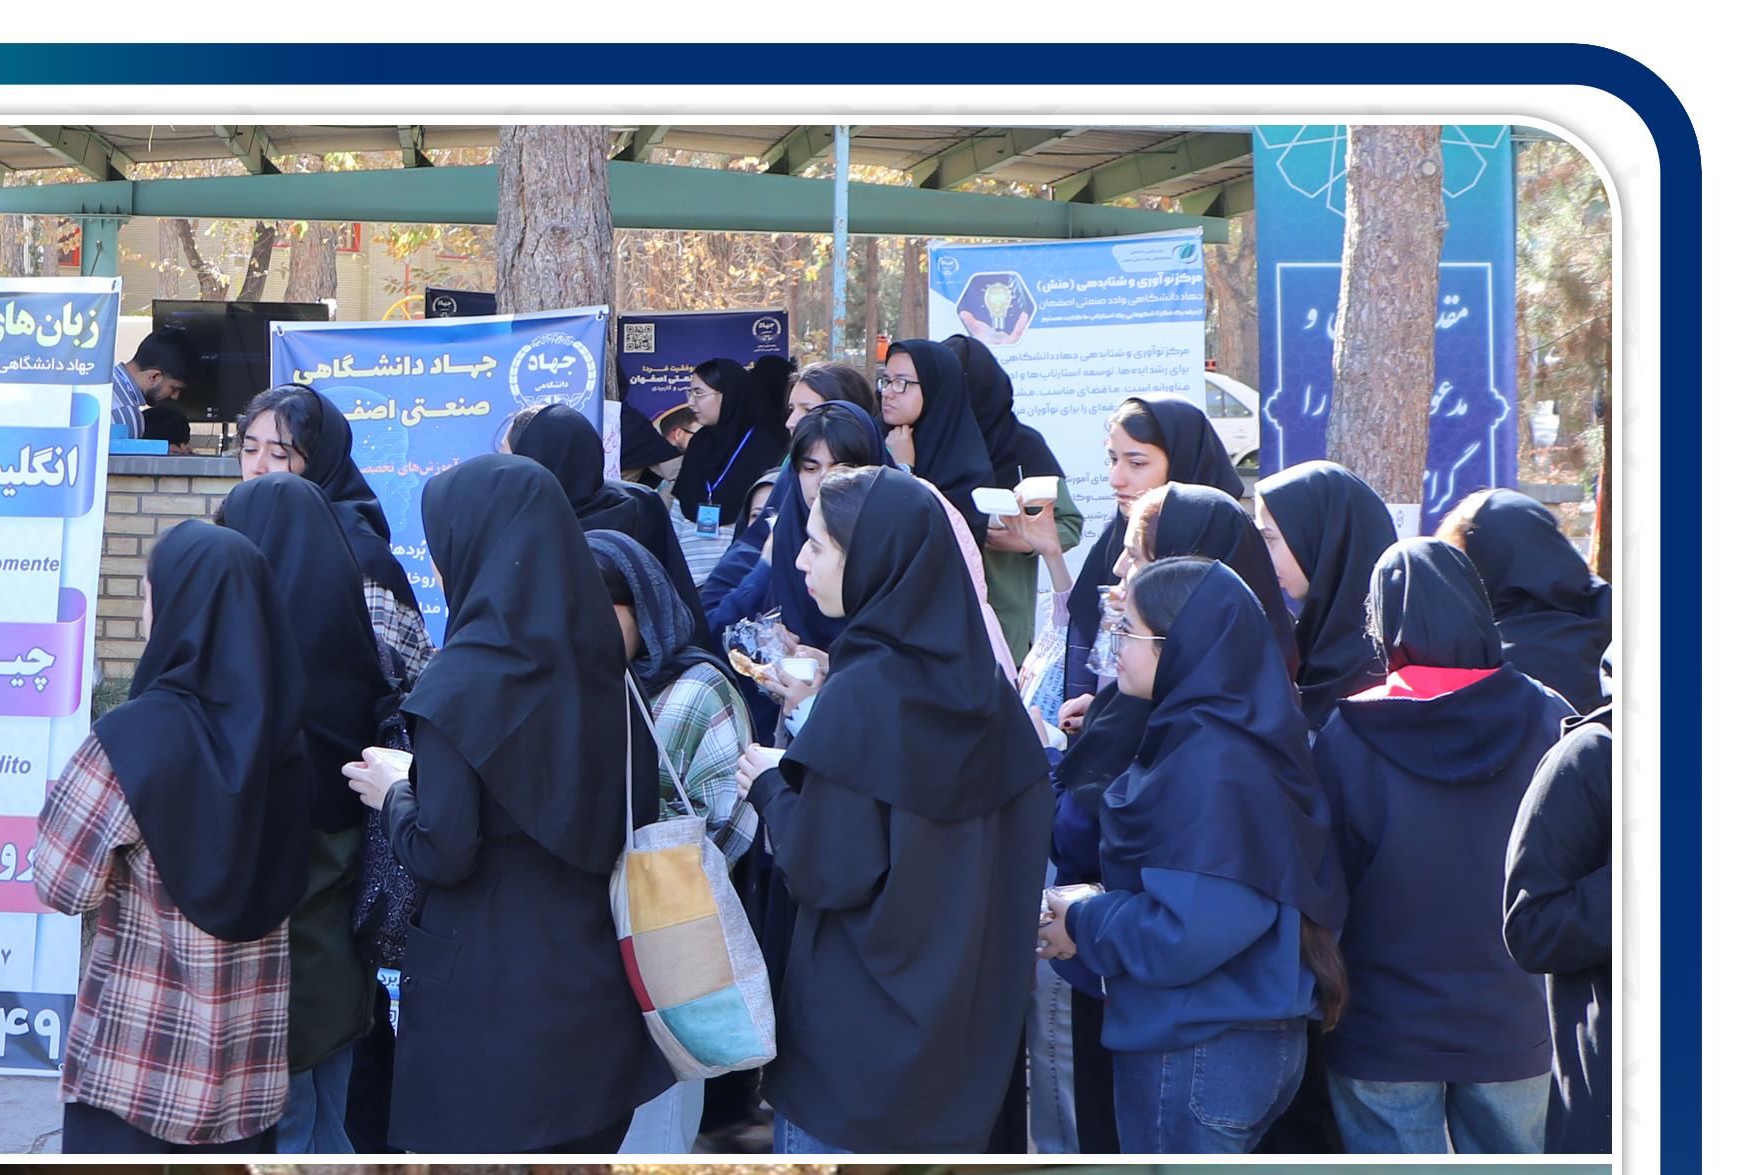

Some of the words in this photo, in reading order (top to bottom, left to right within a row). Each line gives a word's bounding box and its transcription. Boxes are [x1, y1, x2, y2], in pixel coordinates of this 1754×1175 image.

[66, 359, 95, 376] جهاد
[293, 351, 425, 387] دانشگاهی
[429, 353, 498, 381] جهاد
[527, 349, 577, 376] جهاد
[345, 397, 396, 422] اصف
[400, 396, 492, 427] صنعتی
